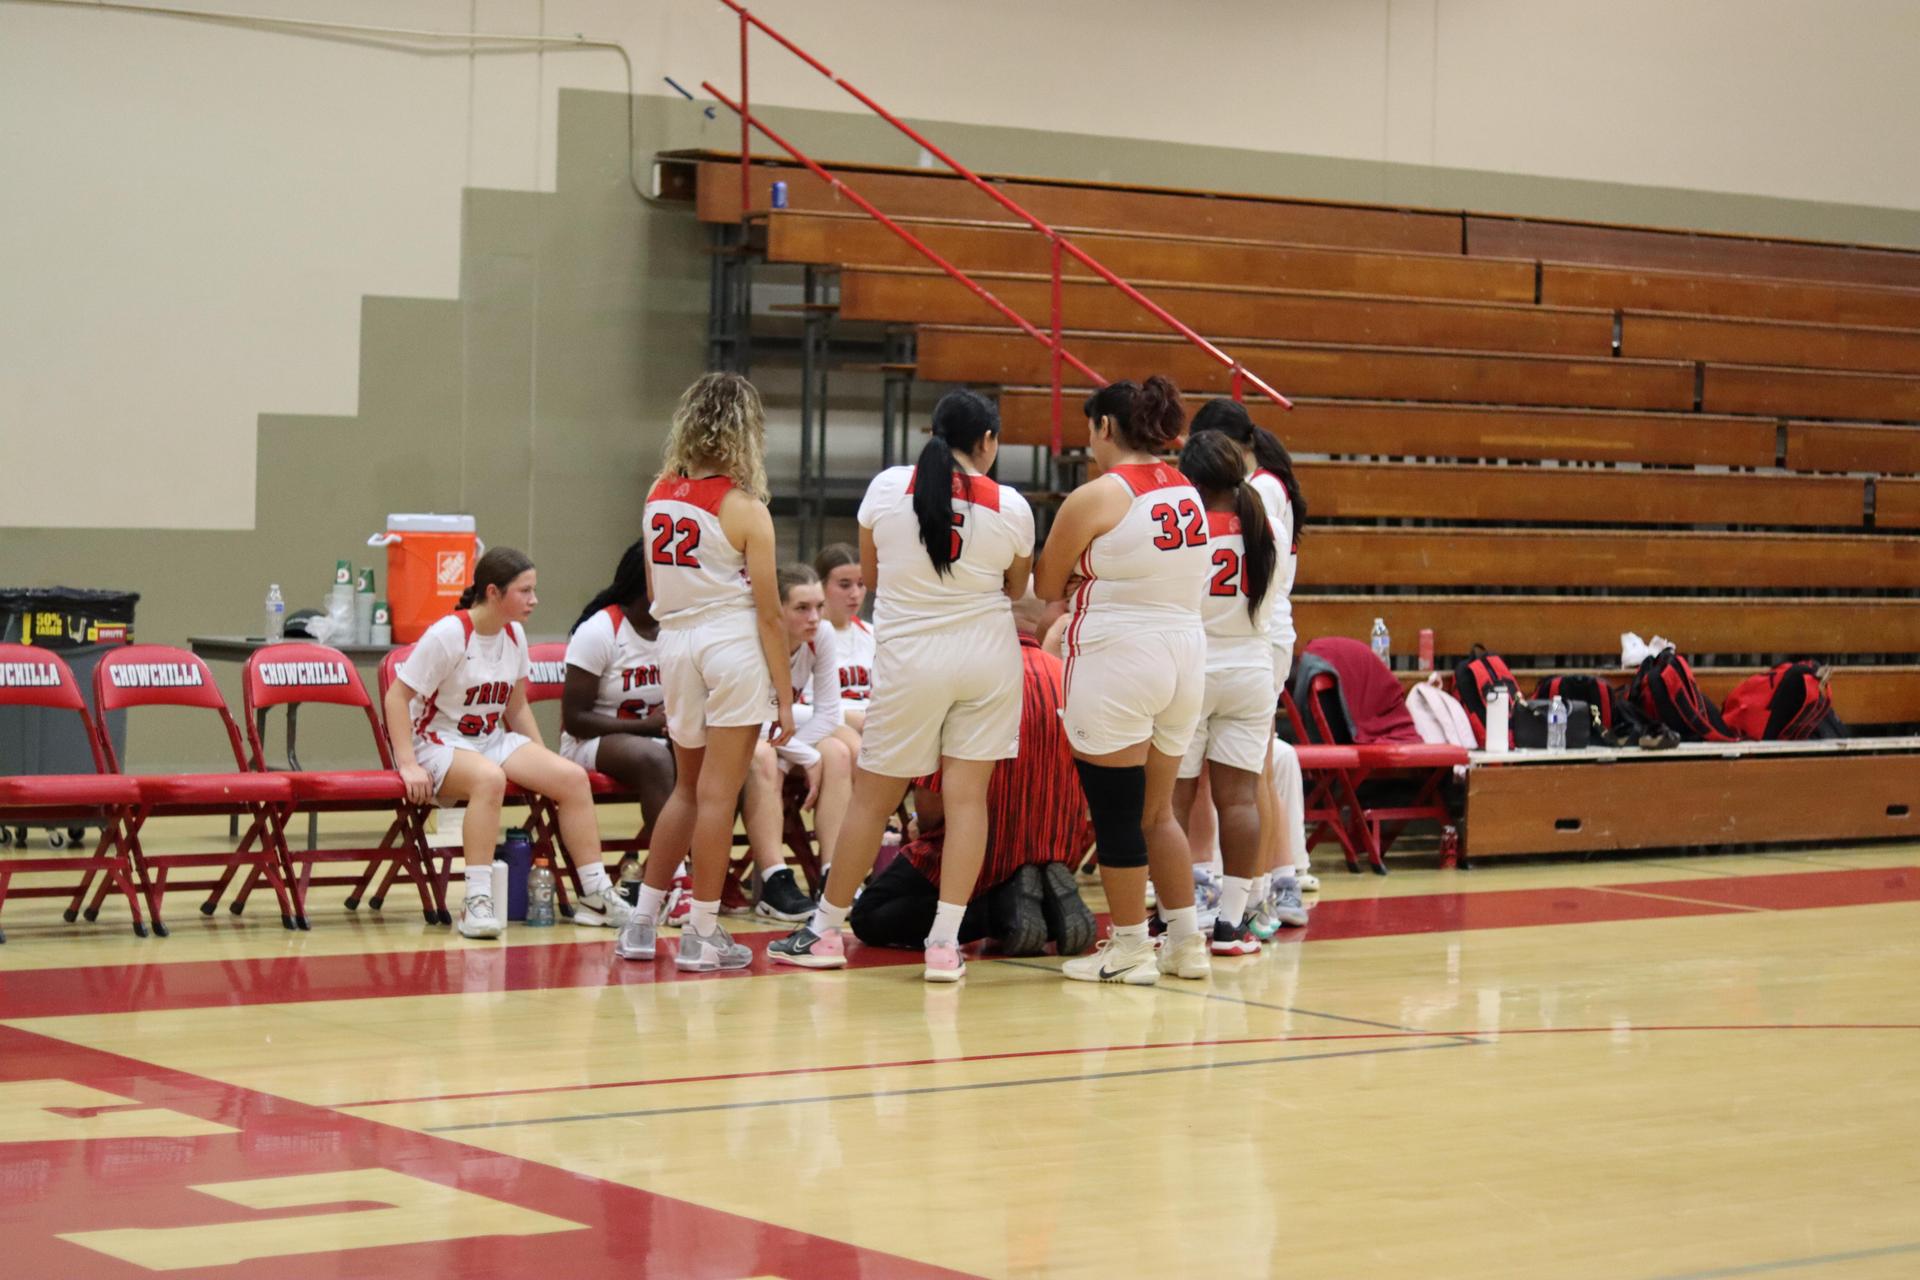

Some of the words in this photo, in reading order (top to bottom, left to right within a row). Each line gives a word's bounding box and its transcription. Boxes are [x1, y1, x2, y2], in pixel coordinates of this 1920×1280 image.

[1151, 498, 1207, 551] 32
[651, 513, 701, 569] 22
[1210, 548, 1248, 597] 2
[109, 663, 204, 687] CHOWCHILLA
[259, 661, 349, 686] CHOWCHILLA
[621, 664, 662, 692] TRI
[838, 665, 873, 688] RIB
[463, 681, 514, 707] TRIB
